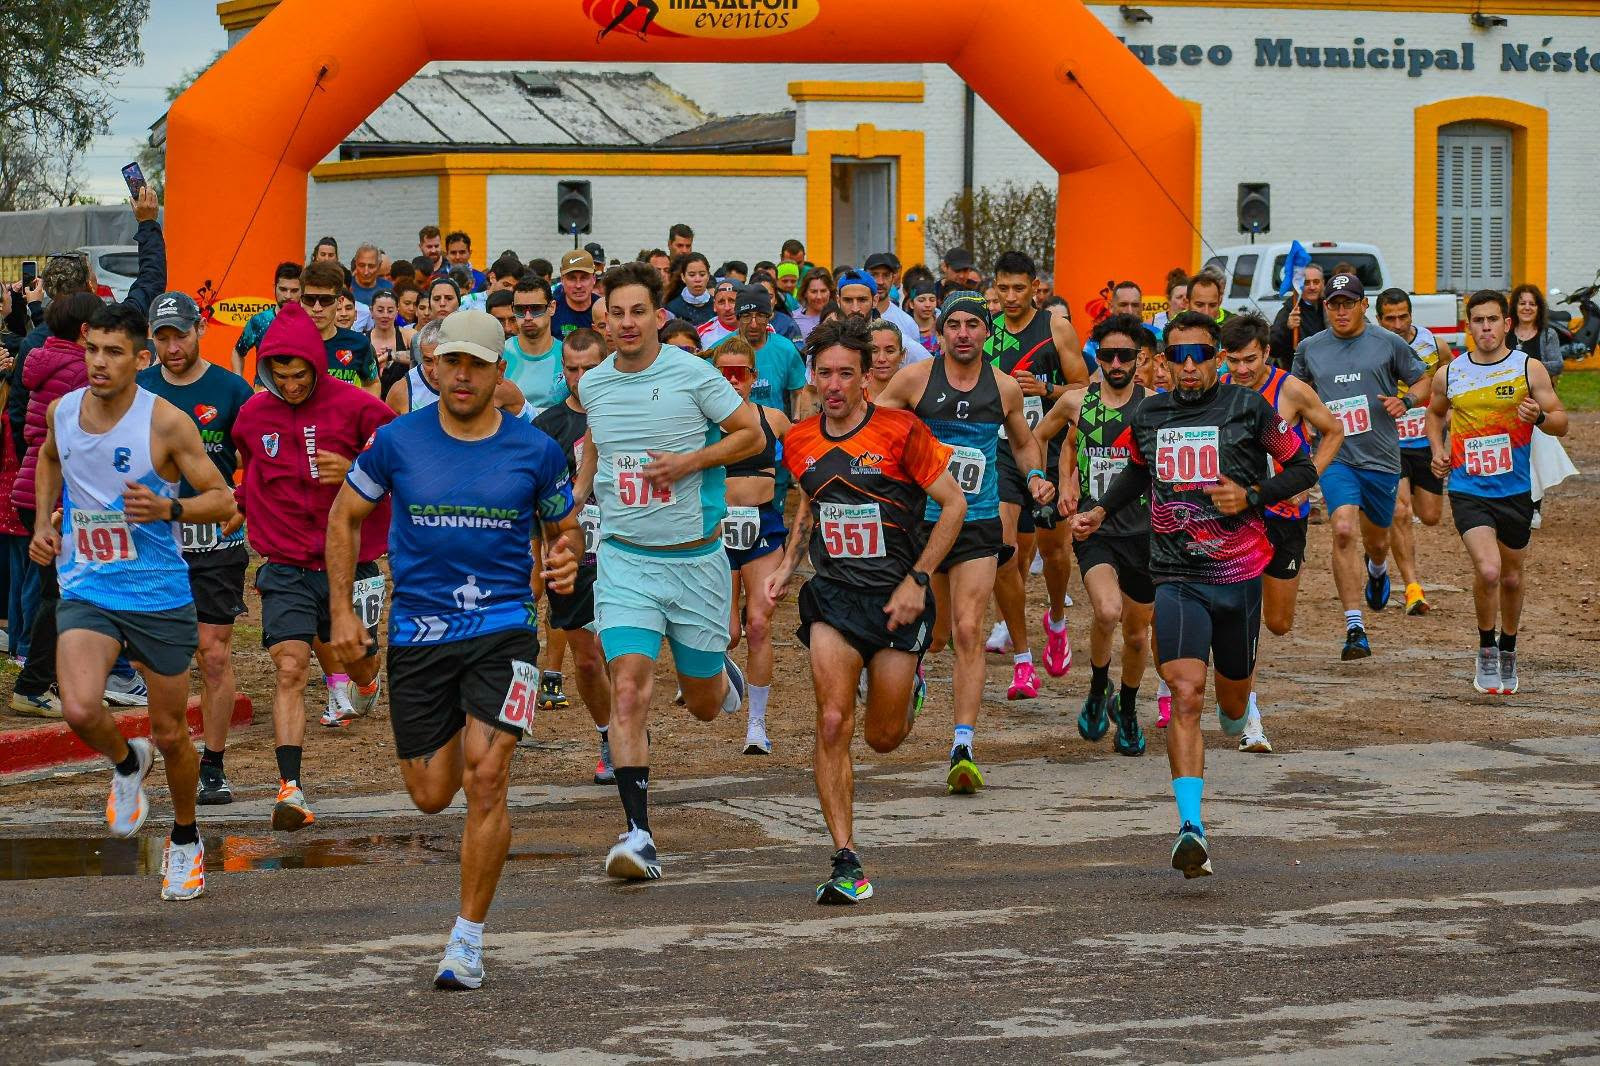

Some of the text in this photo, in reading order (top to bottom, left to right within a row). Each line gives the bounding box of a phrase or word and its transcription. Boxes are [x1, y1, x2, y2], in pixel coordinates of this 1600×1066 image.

[694, 10, 790, 29] eventos
[1117, 38, 1232, 66] useo
[1255, 37, 1475, 77] Municipal
[1334, 373, 1361, 384] RUN
[1332, 408, 1369, 433] 19
[1157, 444, 1218, 480] 500
[1468, 447, 1512, 475] 554
[619, 472, 672, 506] 574
[411, 515, 513, 529] RUNNING
[845, 508, 876, 516] RUFF
[77, 527, 129, 561] 497
[724, 521, 757, 548] 50
[824, 522, 879, 556] 557
